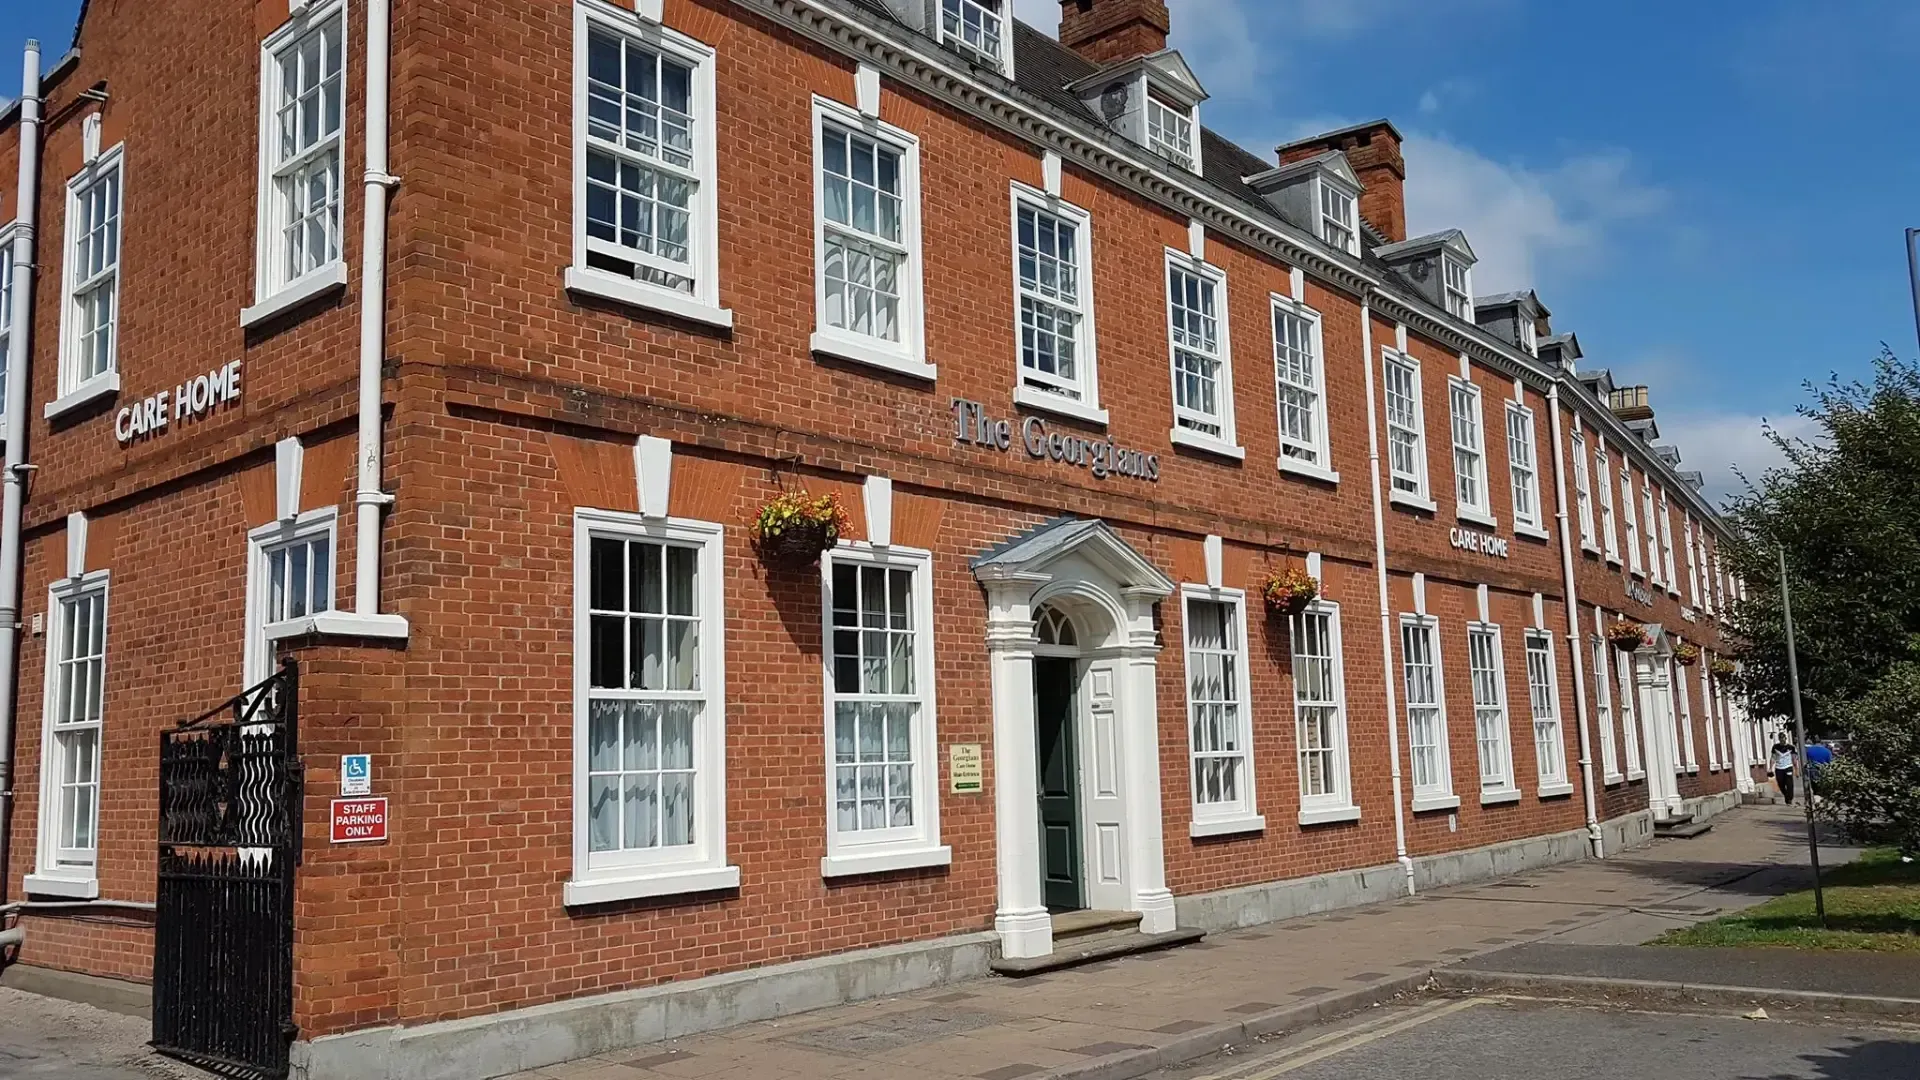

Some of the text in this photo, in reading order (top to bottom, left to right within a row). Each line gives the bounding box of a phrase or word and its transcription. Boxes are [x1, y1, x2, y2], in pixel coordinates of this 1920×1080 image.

[115, 359, 241, 442] CARE HOME
[950, 398, 1159, 481] The Georgians
[1450, 527, 1508, 558] CARE HOME
[953, 754, 979, 762] Georgians
[343, 803, 377, 814] STAFF
[336, 814, 383, 826] PARKING
[345, 825, 373, 837] ONLY
